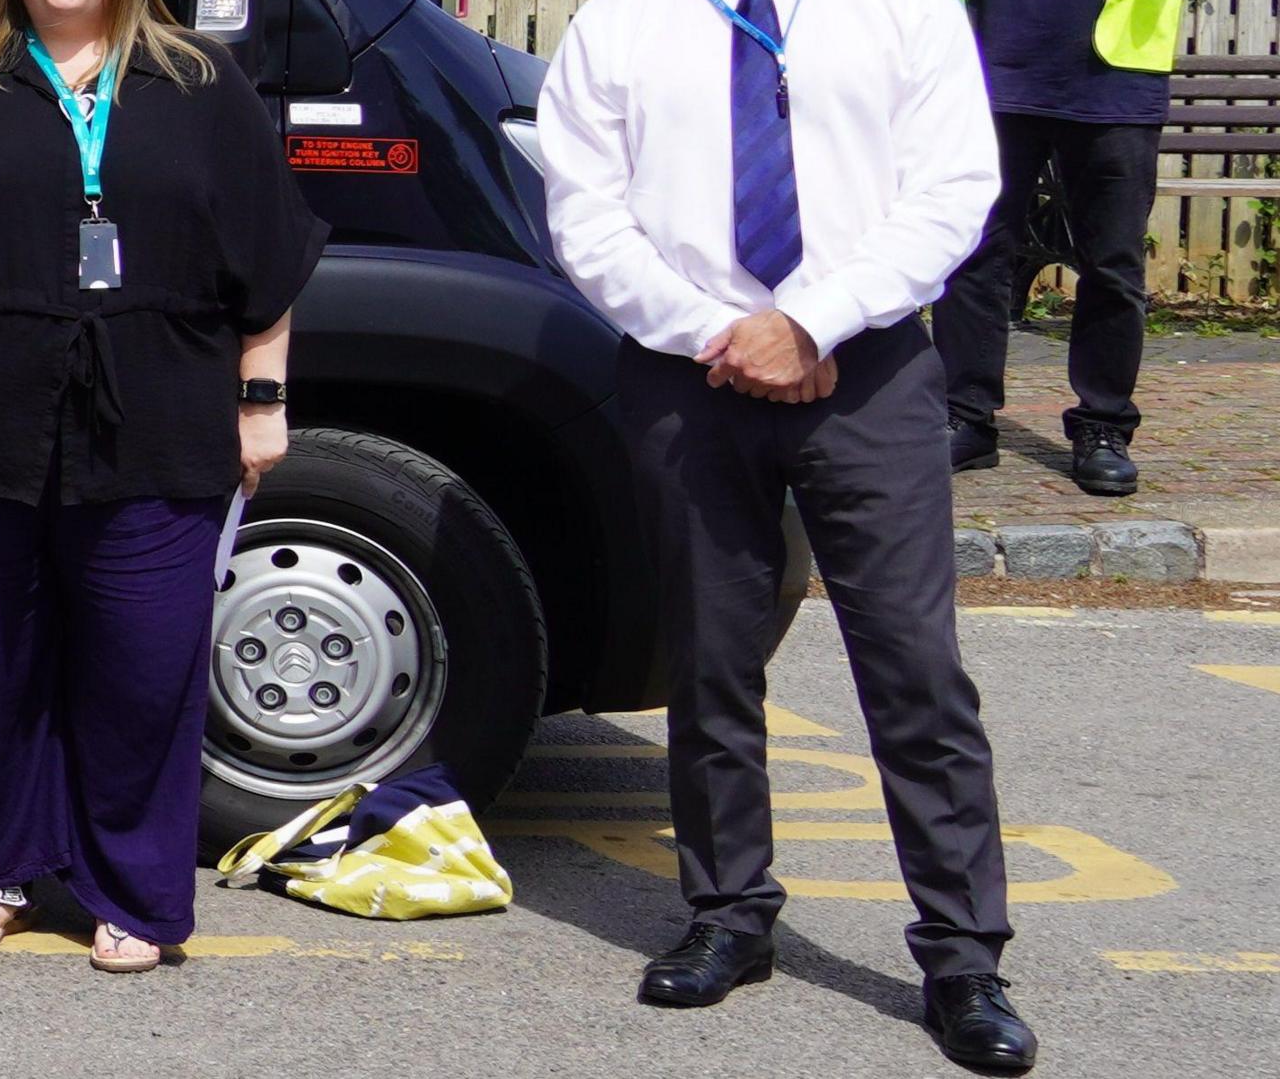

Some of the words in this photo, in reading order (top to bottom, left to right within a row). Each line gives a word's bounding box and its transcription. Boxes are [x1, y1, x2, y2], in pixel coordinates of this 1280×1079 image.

[302, 140, 315, 148] TO
[316, 141, 339, 149] STOP
[340, 141, 374, 150] ENGINE
[295, 149, 320, 157] TURN
[321, 150, 360, 158] IGNITION
[361, 151, 380, 159] KEY
[288, 157, 303, 165] ON
[304, 158, 348, 166] STEERING
